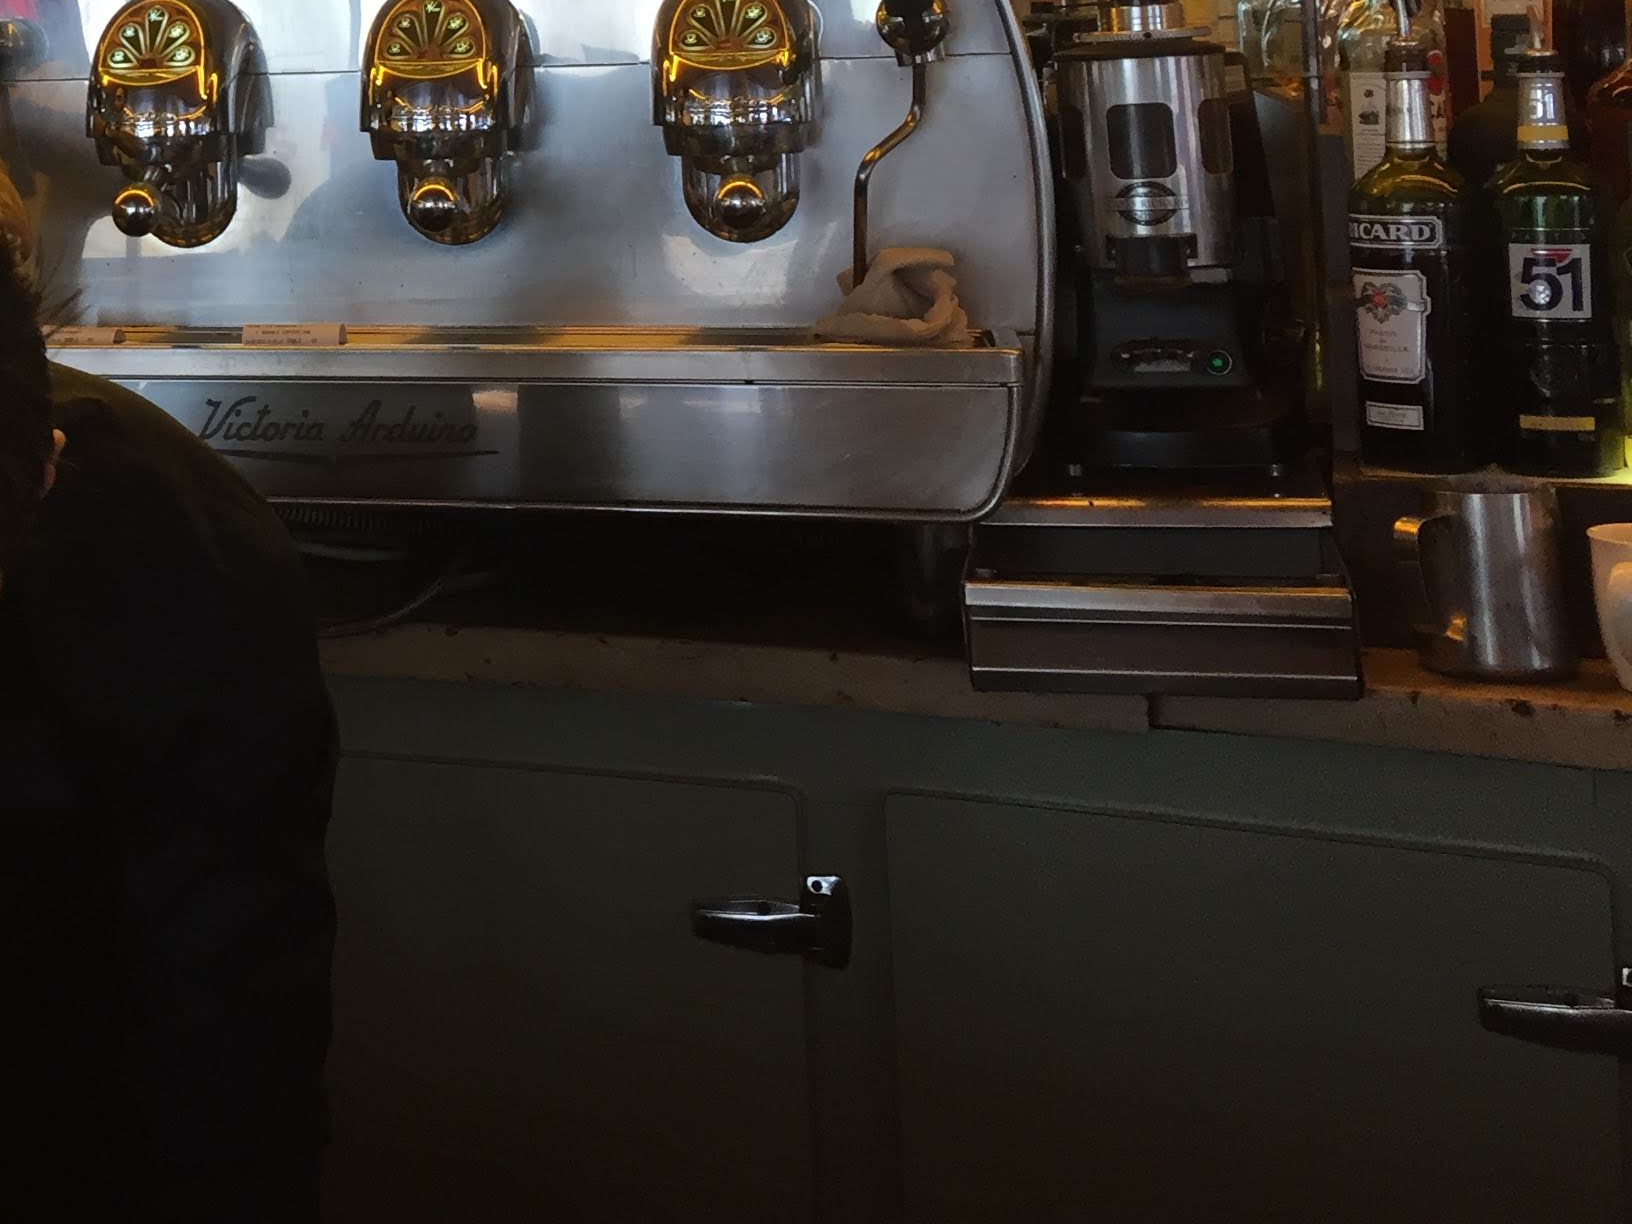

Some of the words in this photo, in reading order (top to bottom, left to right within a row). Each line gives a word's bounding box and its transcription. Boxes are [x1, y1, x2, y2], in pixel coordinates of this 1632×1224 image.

[1529, 89, 1555, 119] 51
[1520, 257, 1584, 312] 51
[199, 396, 325, 442] Victoria
[339, 399, 479, 443] Arduino
